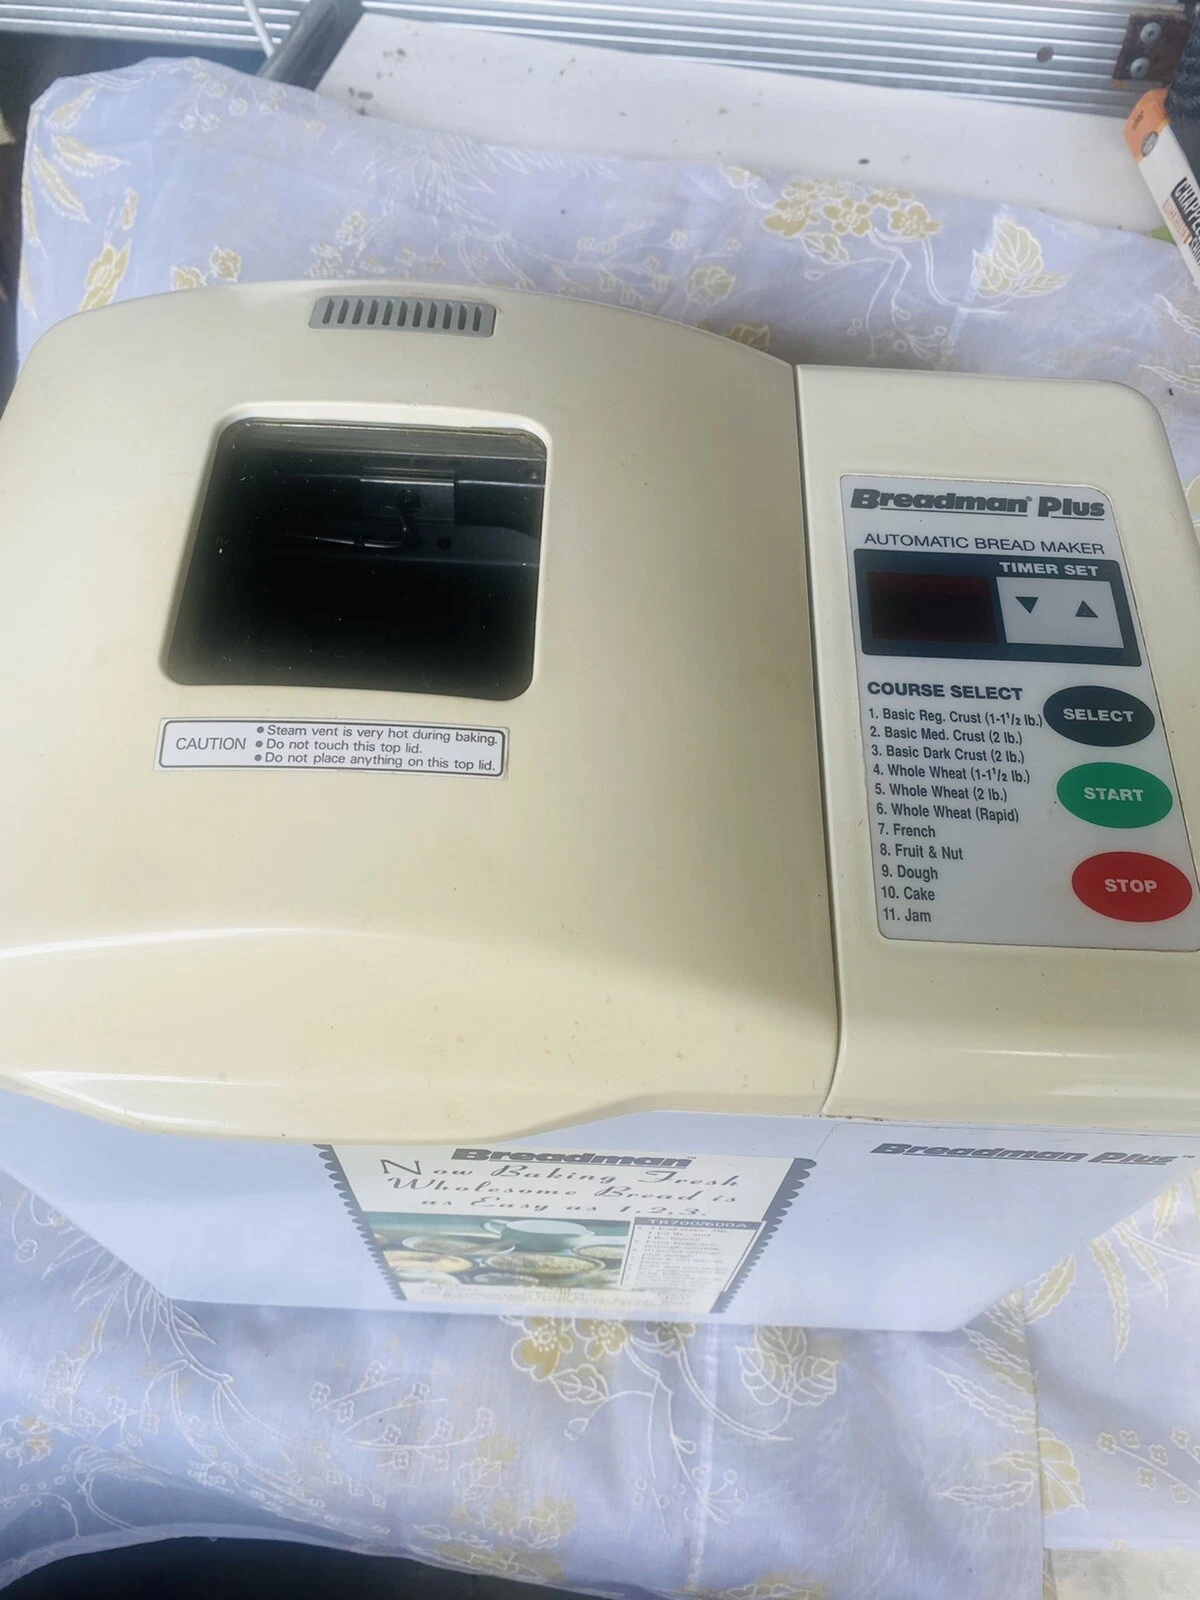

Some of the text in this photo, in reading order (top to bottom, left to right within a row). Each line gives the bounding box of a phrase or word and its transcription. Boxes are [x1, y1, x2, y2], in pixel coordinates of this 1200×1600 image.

[1038, 496, 1105, 518] Plus
[864, 533, 1105, 555] AUTOMATIC BREAD MAKER
[999, 561, 1099, 577] TIMER SET
[867, 681, 1022, 701] COURSE SELECT
[868, 708, 879, 719] 1.
[882, 707, 915, 721] Basic
[919, 709, 946, 725] Reg.
[949, 710, 982, 724] Crust
[1024, 714, 1043, 728] lb.)
[1062, 707, 1134, 723] SELECT
[175, 737, 247, 750] CAUTION
[267, 724, 498, 746] Steam vent is very hot during baking.
[870, 726, 1023, 746] 2. Basic Med. Crust (2 lb.)
[266, 738, 423, 755] Do not touch this top lid.
[871, 744, 1025, 765] 3. Basic Dark Crust (2 lb.)
[265, 752, 495, 771] Do not place anything on this top lid.
[873, 763, 884, 776] 4.
[887, 763, 925, 778] Whole
[929, 765, 967, 780] Wheat
[1011, 769, 1030, 784] lb.)
[875, 783, 1008, 803] 5. Whole Wheat (2 lb.)
[1083, 787, 1144, 802] START
[876, 802, 1019, 824] 6. Whole Wheat (Rapid)
[878, 823, 936, 838] 7. French
[880, 843, 964, 860] 8. Fruit & Nut
[881, 864, 938, 881] 9. Dough
[880, 885, 935, 901] 10. Cake
[1104, 878, 1158, 894] STOP
[882, 907, 931, 923] 11. Jam
[451, 1148, 693, 1168] Breadman
[870, 1143, 1178, 1165] Breadman Plus
[380, 1159, 739, 1187] Now Baking Fresh
[387, 1177, 576, 1195] Wholesome
[594, 1186, 703, 1200] Bread
[471, 1196, 548, 1211] Easy
